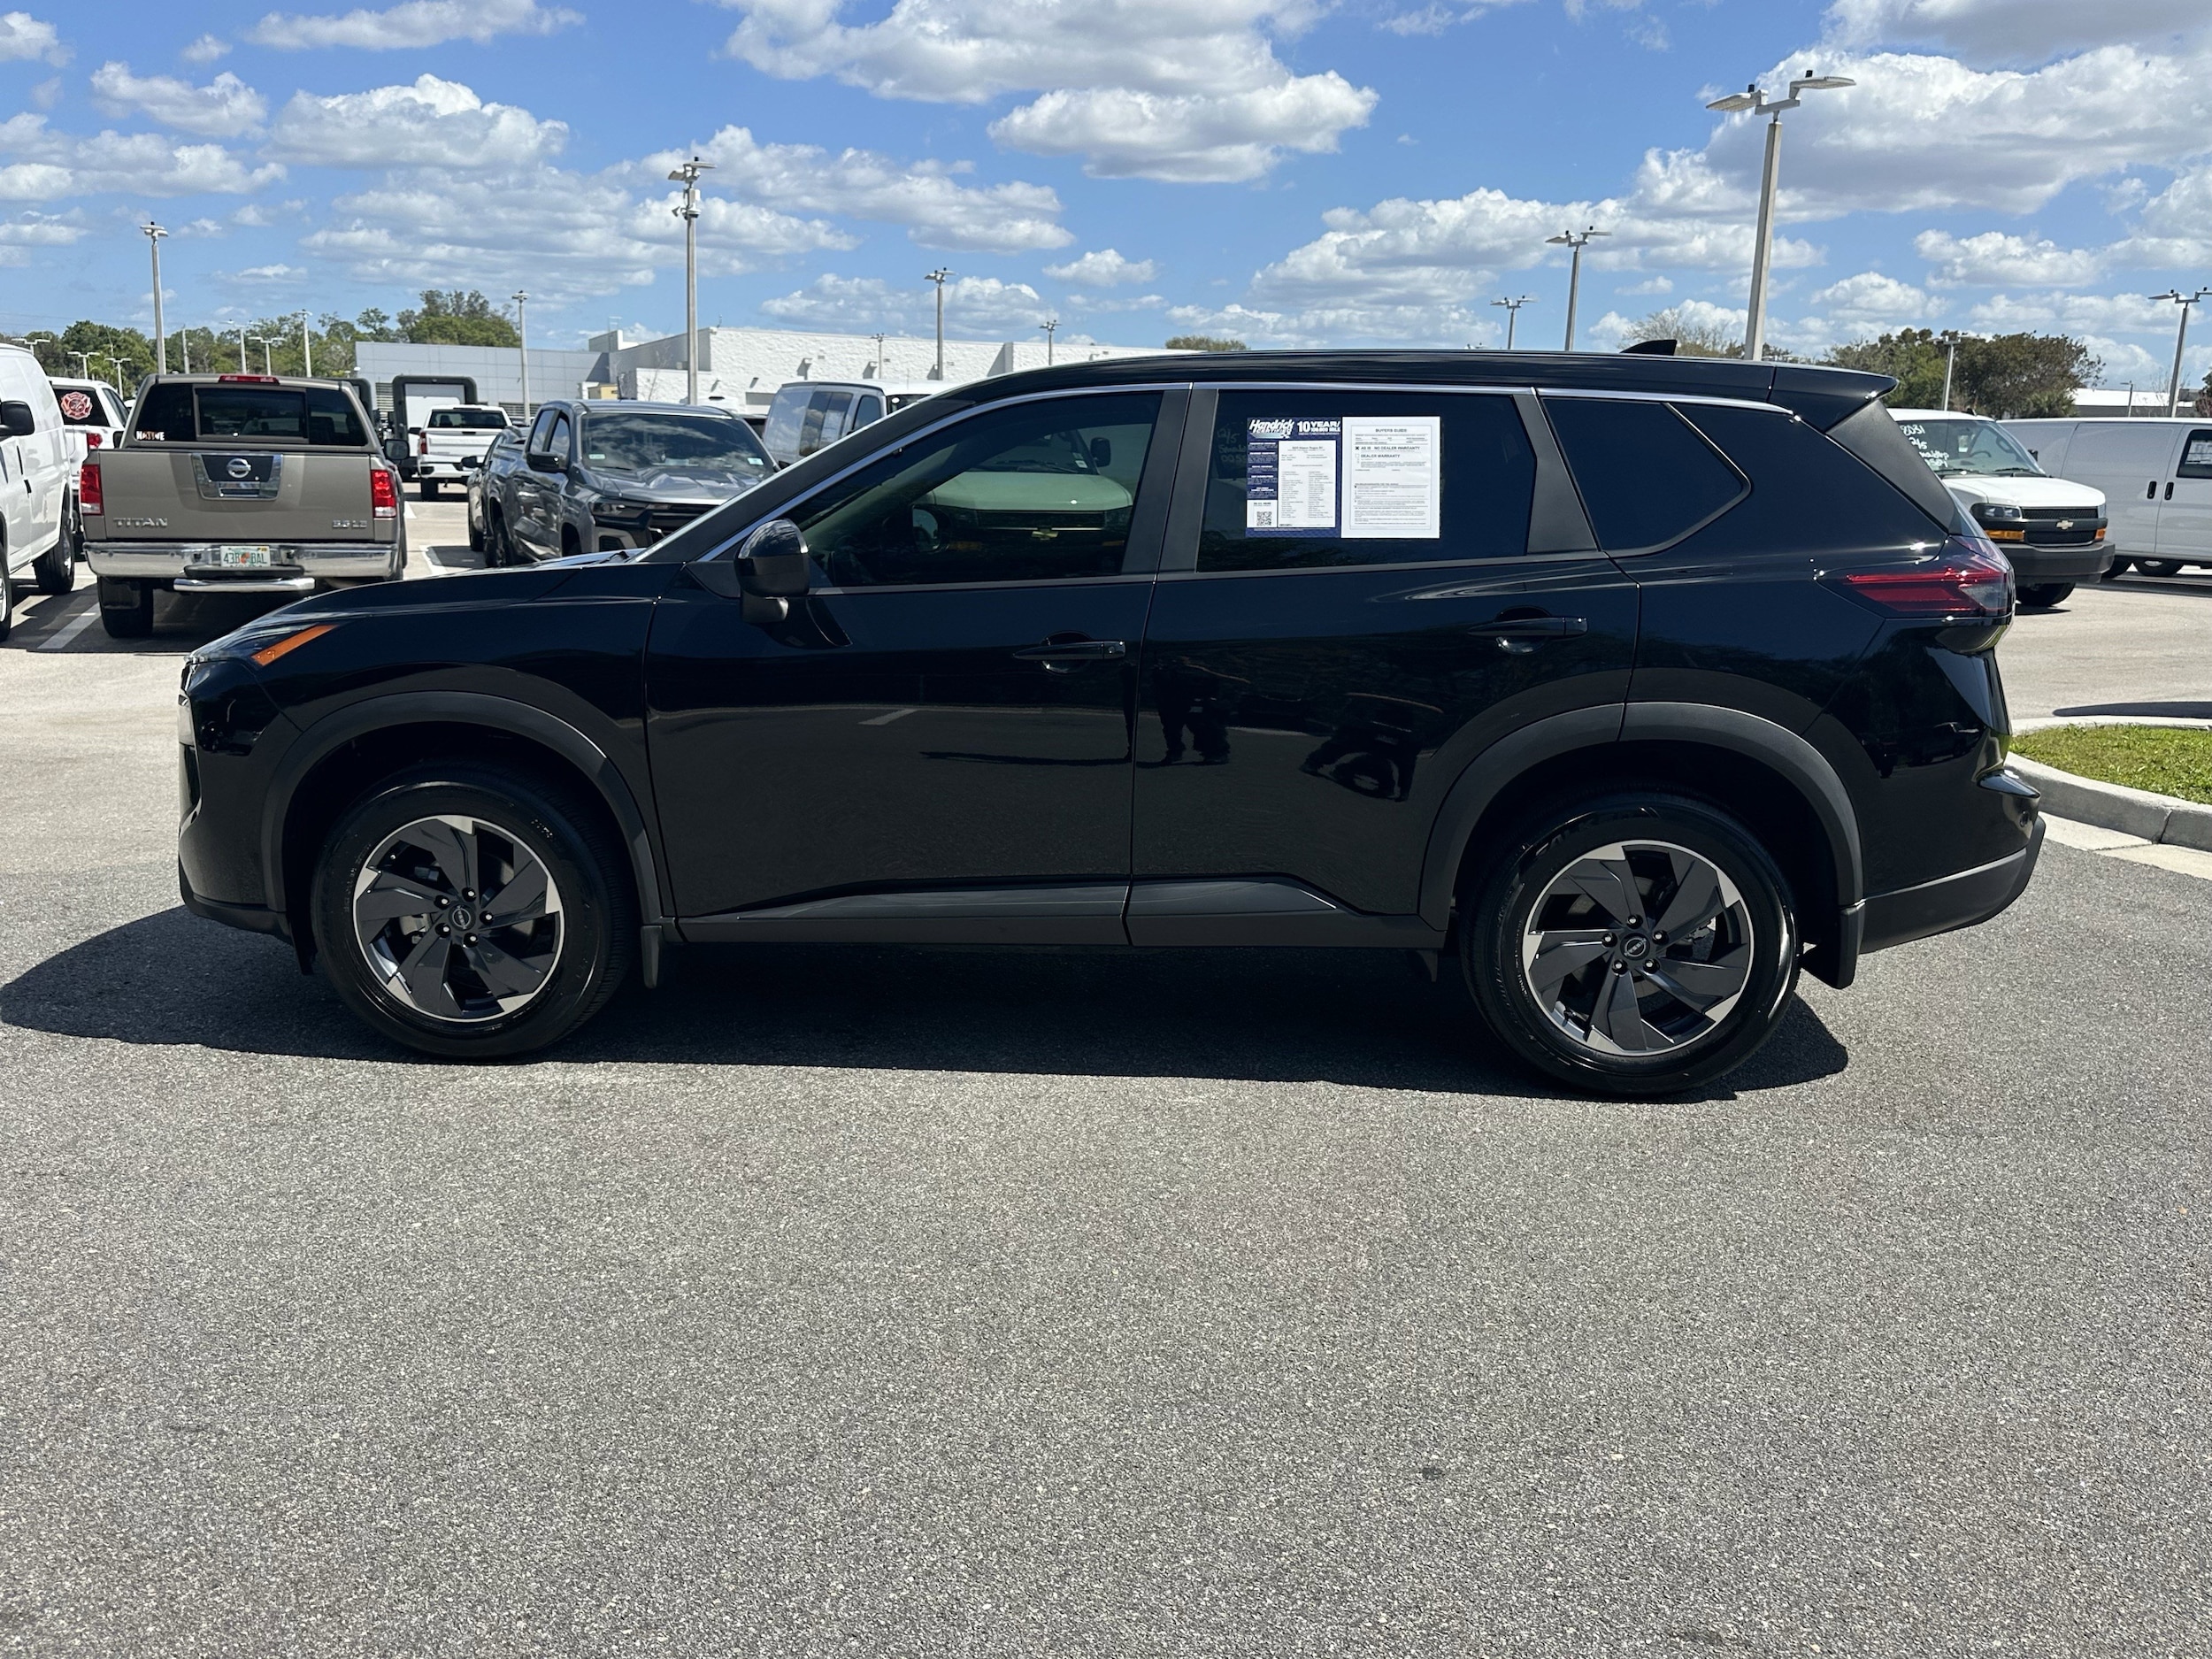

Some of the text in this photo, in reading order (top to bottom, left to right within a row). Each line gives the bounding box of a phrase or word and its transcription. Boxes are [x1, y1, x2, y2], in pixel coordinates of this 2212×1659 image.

[1297, 420, 1310, 433] 10
[135, 430, 165, 441] NATIVE
[113, 517, 168, 528] TITAN
